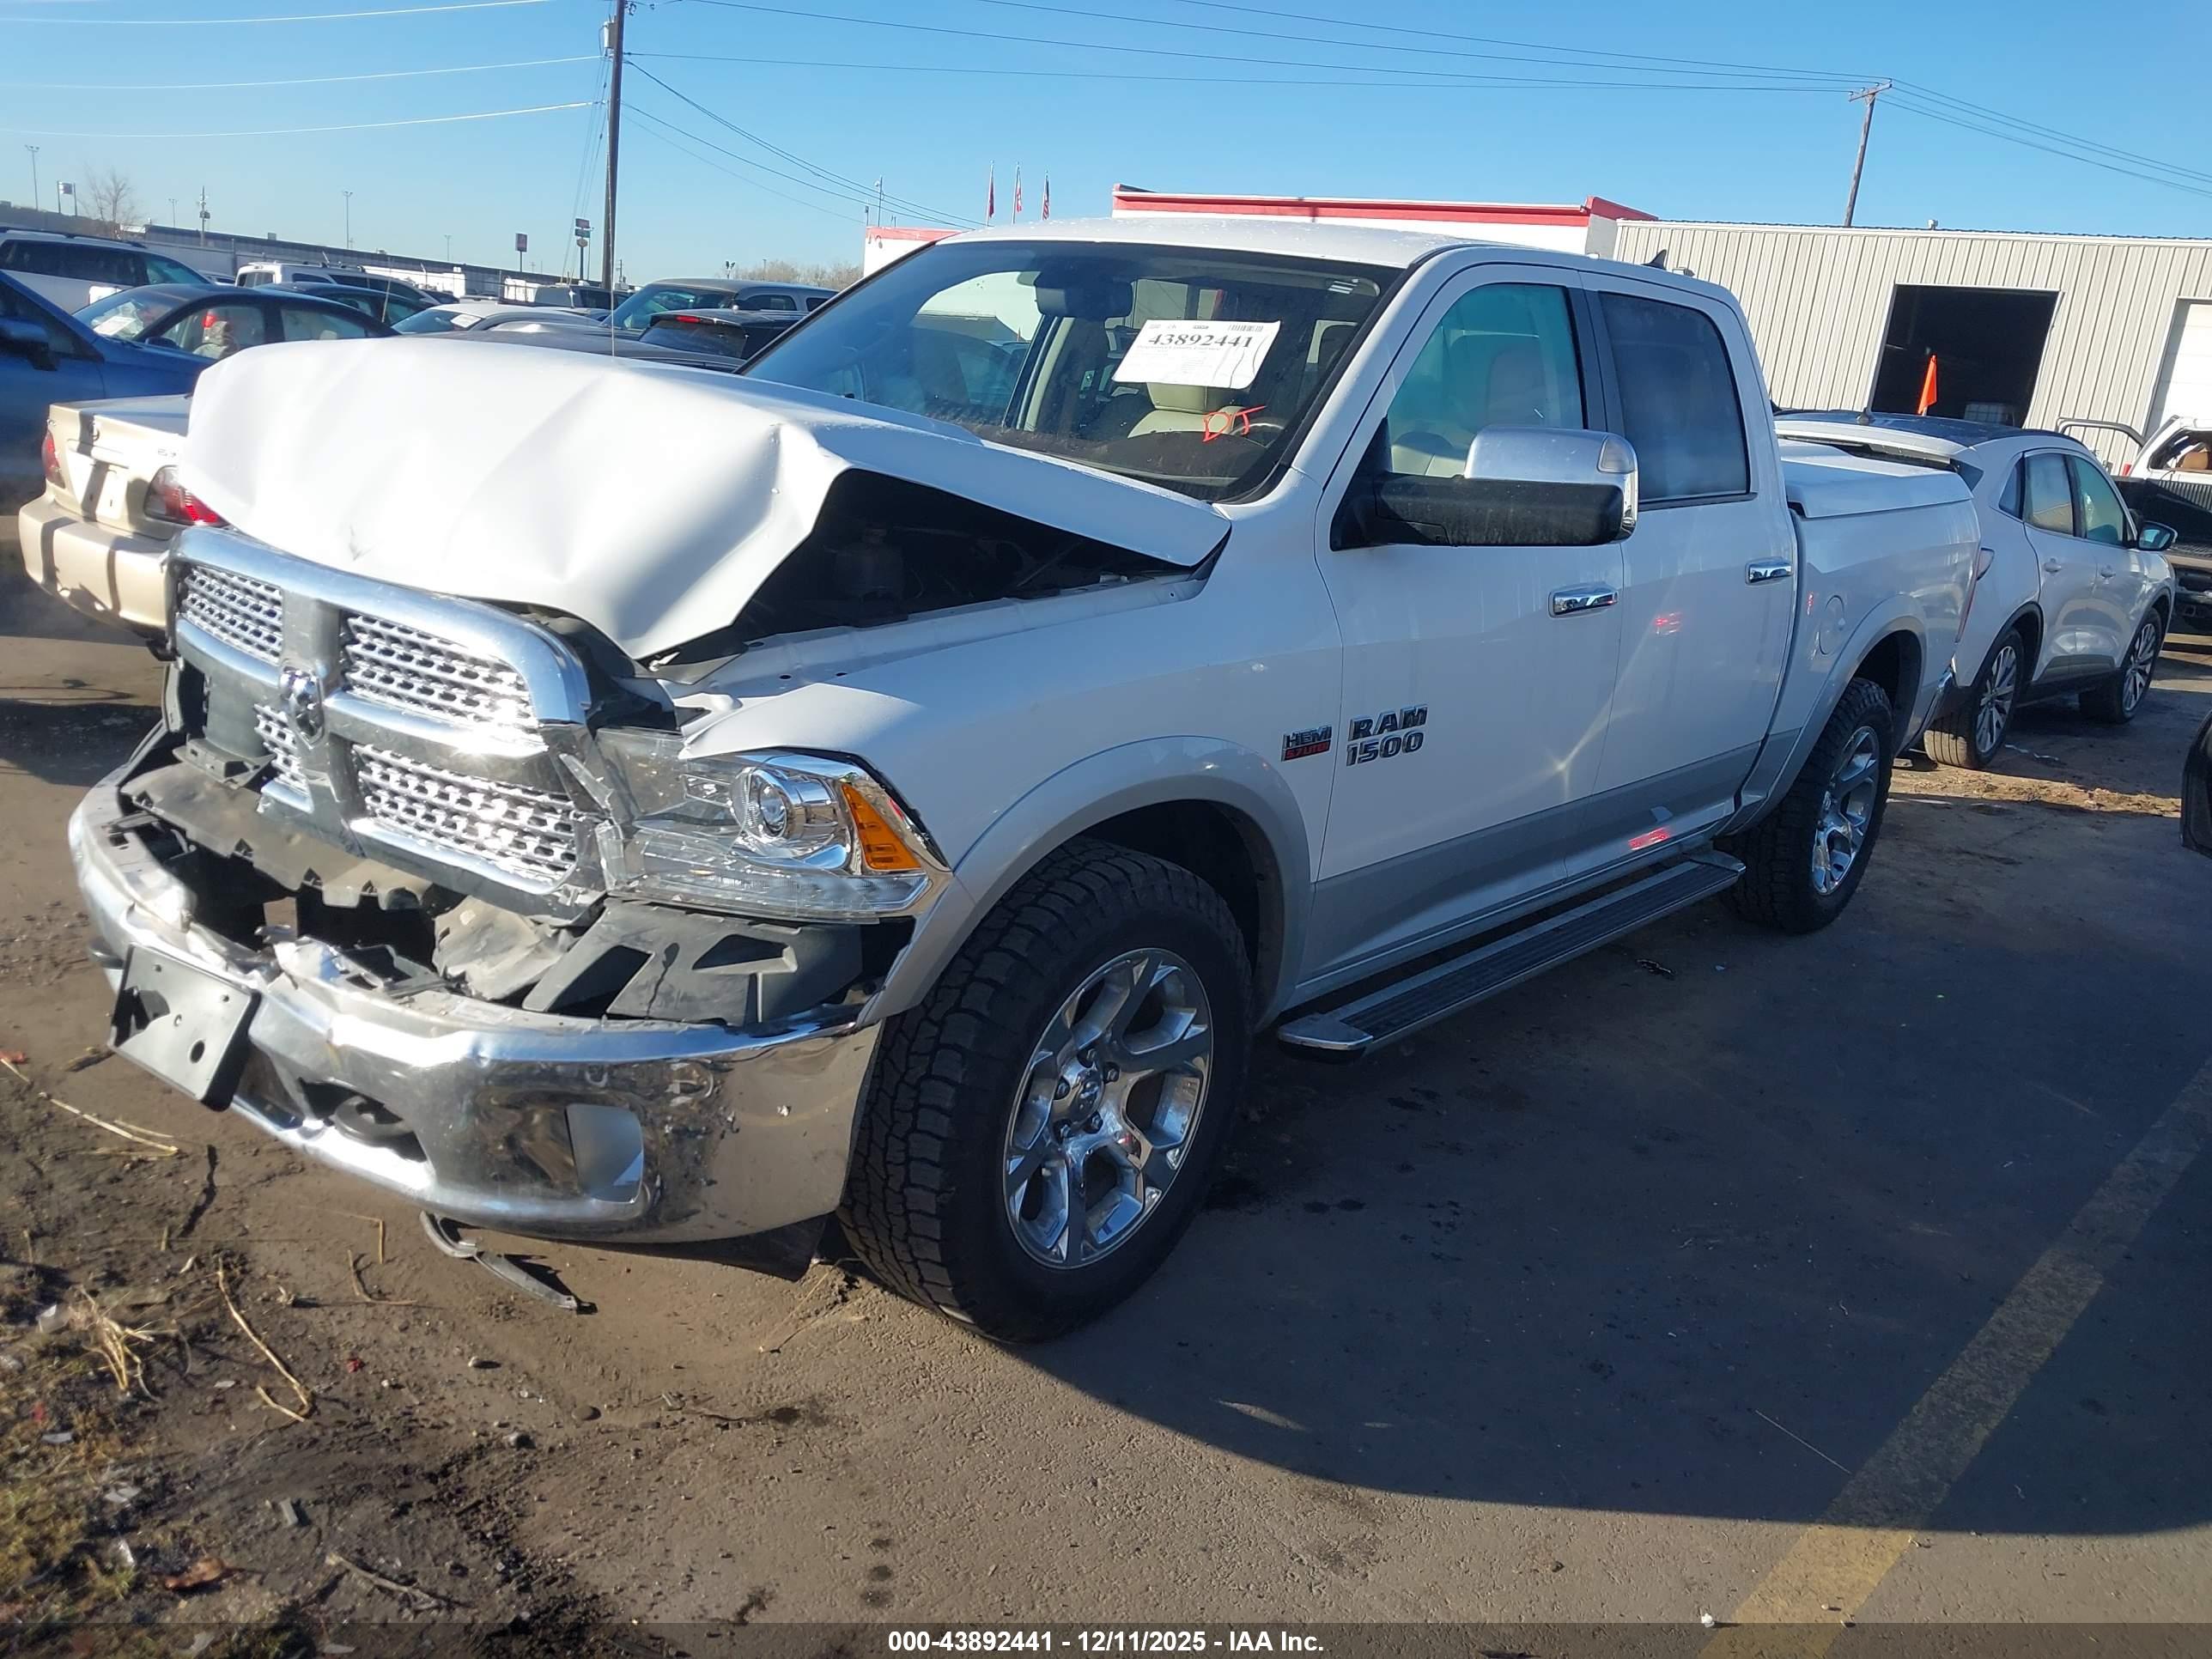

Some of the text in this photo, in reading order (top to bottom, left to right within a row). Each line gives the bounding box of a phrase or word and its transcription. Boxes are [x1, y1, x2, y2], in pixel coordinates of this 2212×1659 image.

[1148, 333, 1253, 348] 43892441
[1348, 704, 1428, 741] RAM
[1282, 726, 1332, 749] HEMI
[1346, 730, 1425, 766] 1500
